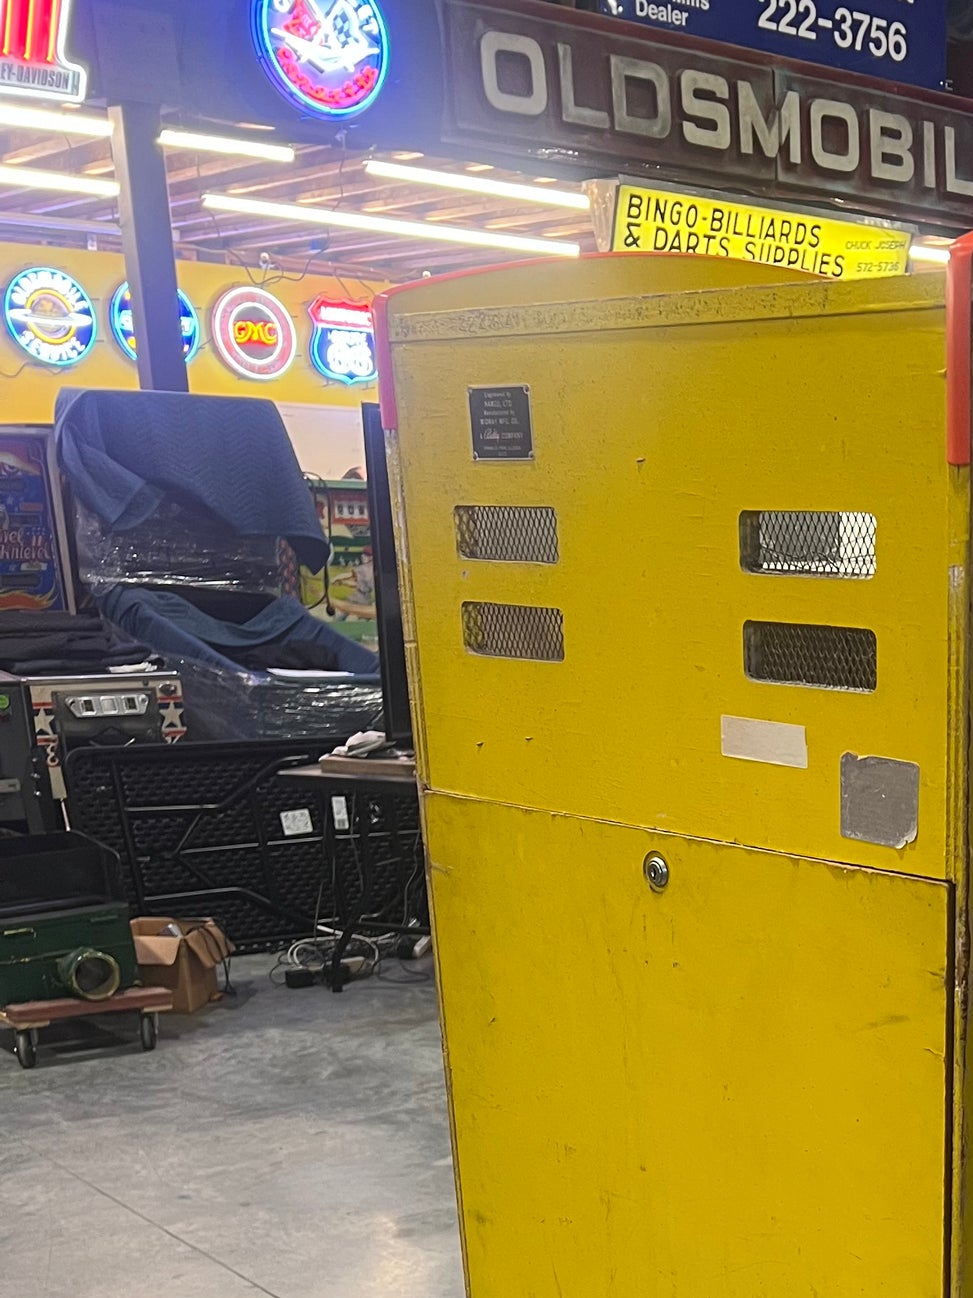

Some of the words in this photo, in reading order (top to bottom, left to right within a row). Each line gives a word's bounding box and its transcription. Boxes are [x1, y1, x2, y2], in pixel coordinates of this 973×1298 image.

[635, 0, 689, 26] Dealer
[757, 0, 907, 62] 222-3756
[627, 193, 822, 249] BINGO-BILLIARDS
[624, 222, 641, 248] &
[653, 226, 730, 257] DARTS
[744, 241, 845, 277] SUPPLIES
[234, 320, 278, 345] GMC
